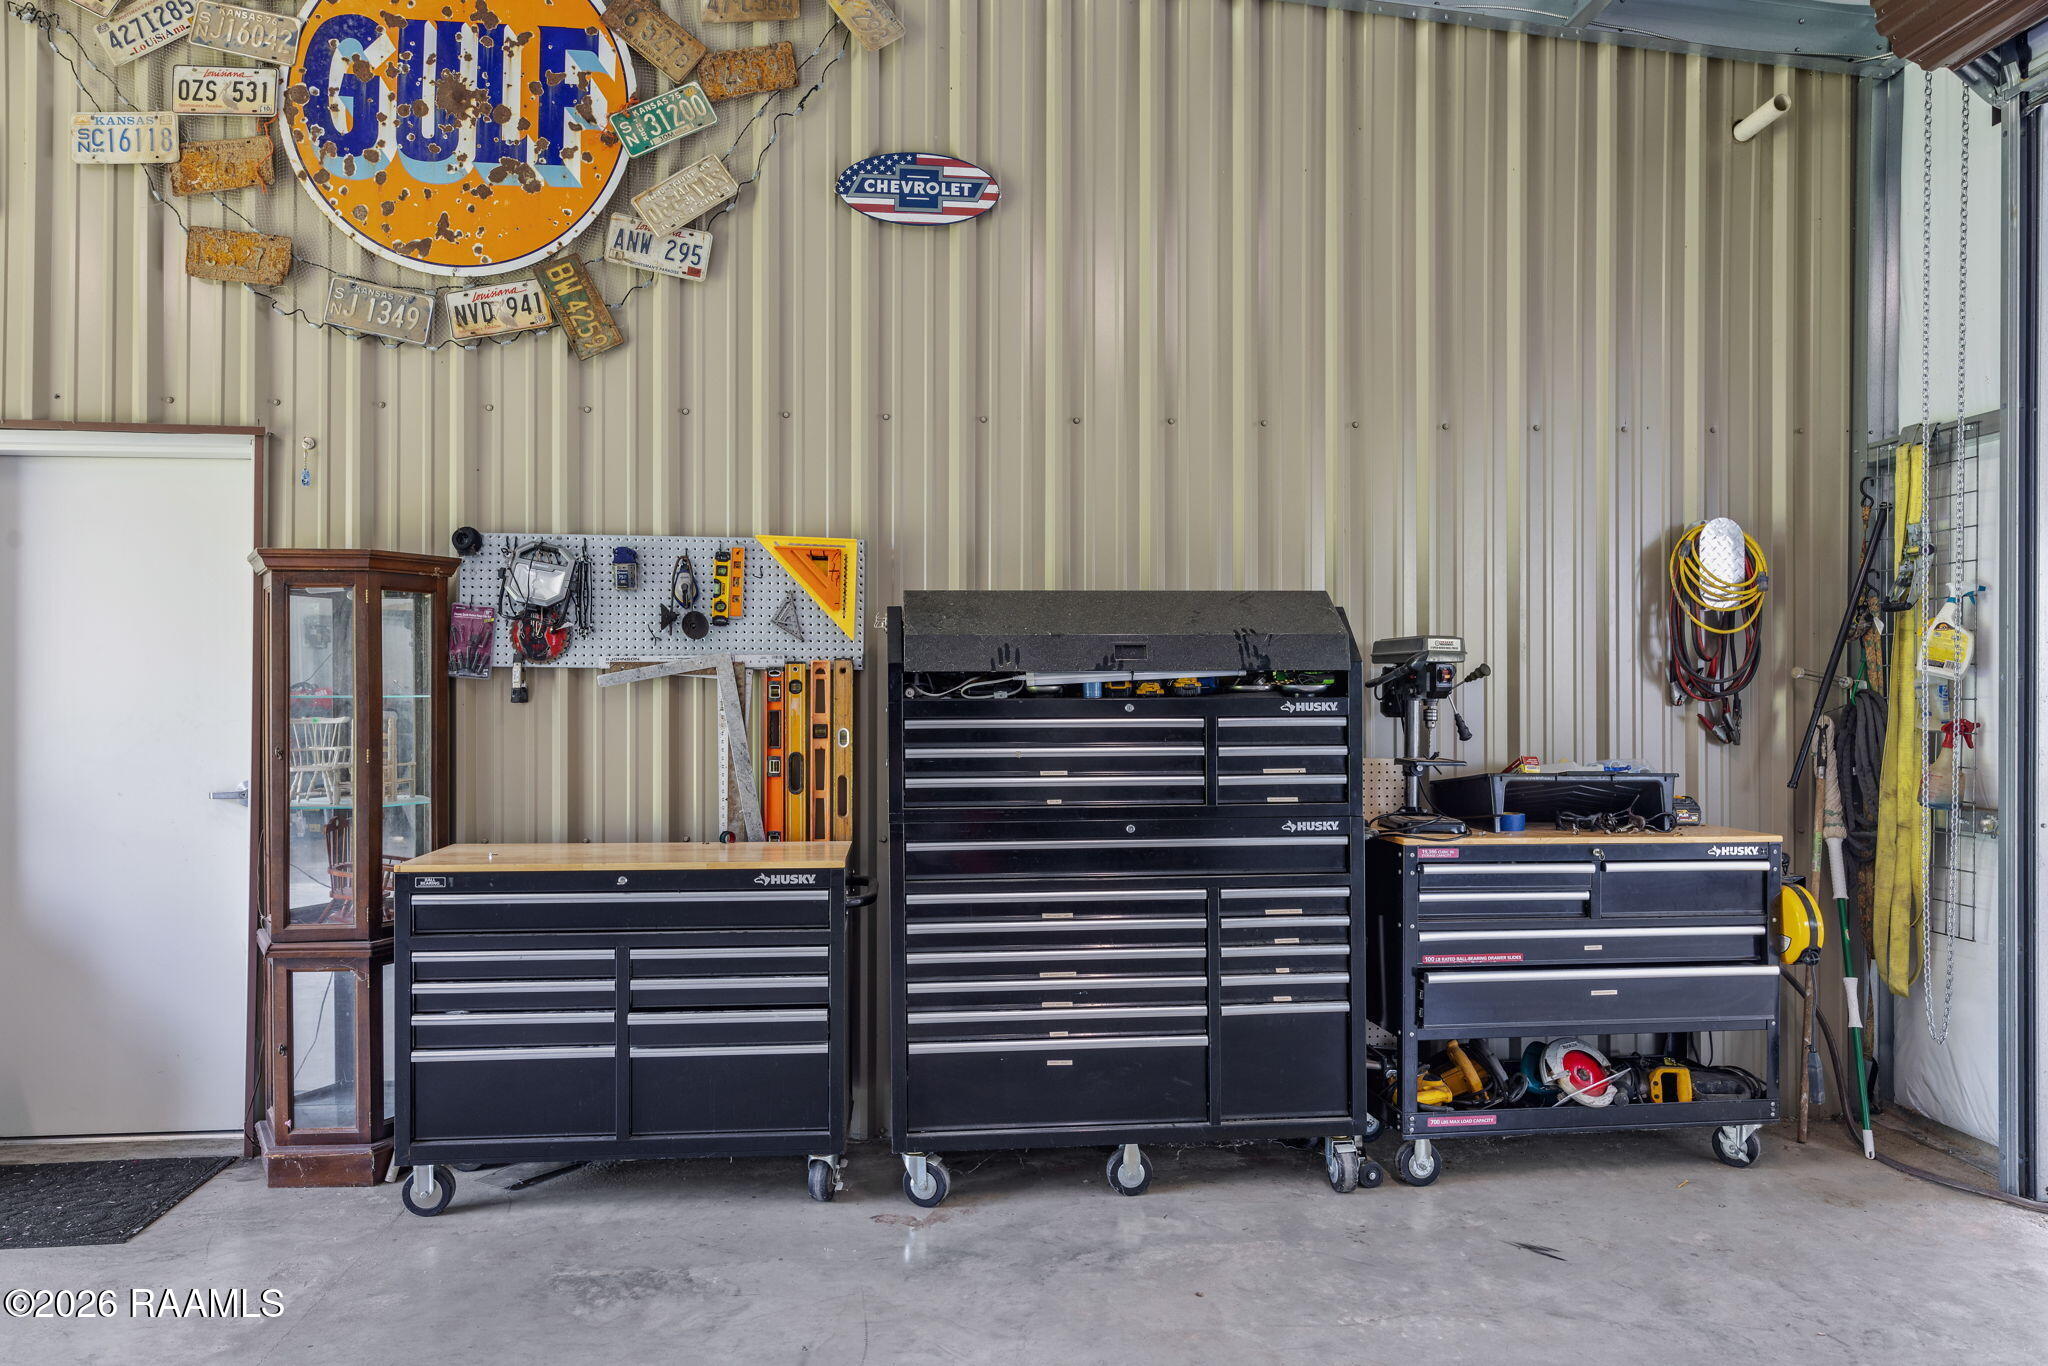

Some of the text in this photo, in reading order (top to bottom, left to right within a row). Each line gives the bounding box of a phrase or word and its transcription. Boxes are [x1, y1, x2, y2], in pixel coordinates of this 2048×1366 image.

[219, 8, 263, 22] KANSAS
[203, 68, 253, 78] Louisiana
[232, 81, 268, 103] 531
[303, 14, 615, 188] GULF
[632, 92, 681, 117] KANSAS 75
[95, 116, 154, 126] KANSAS
[643, 95, 707, 136] 31200
[864, 179, 972, 197] CHEVROLET
[613, 228, 703, 266] ANW 295
[354, 286, 394, 300] KANSAS
[471, 286, 528, 303] Louisiana
[454, 292, 542, 326] NVD 941
[566, 301, 608, 348] 4259
[1296, 702, 1338, 711] HUSKY
[1297, 821, 1339, 831] HUSKY
[1721, 846, 1759, 856] HUSKY
[771, 874, 816, 885] HUSKY
